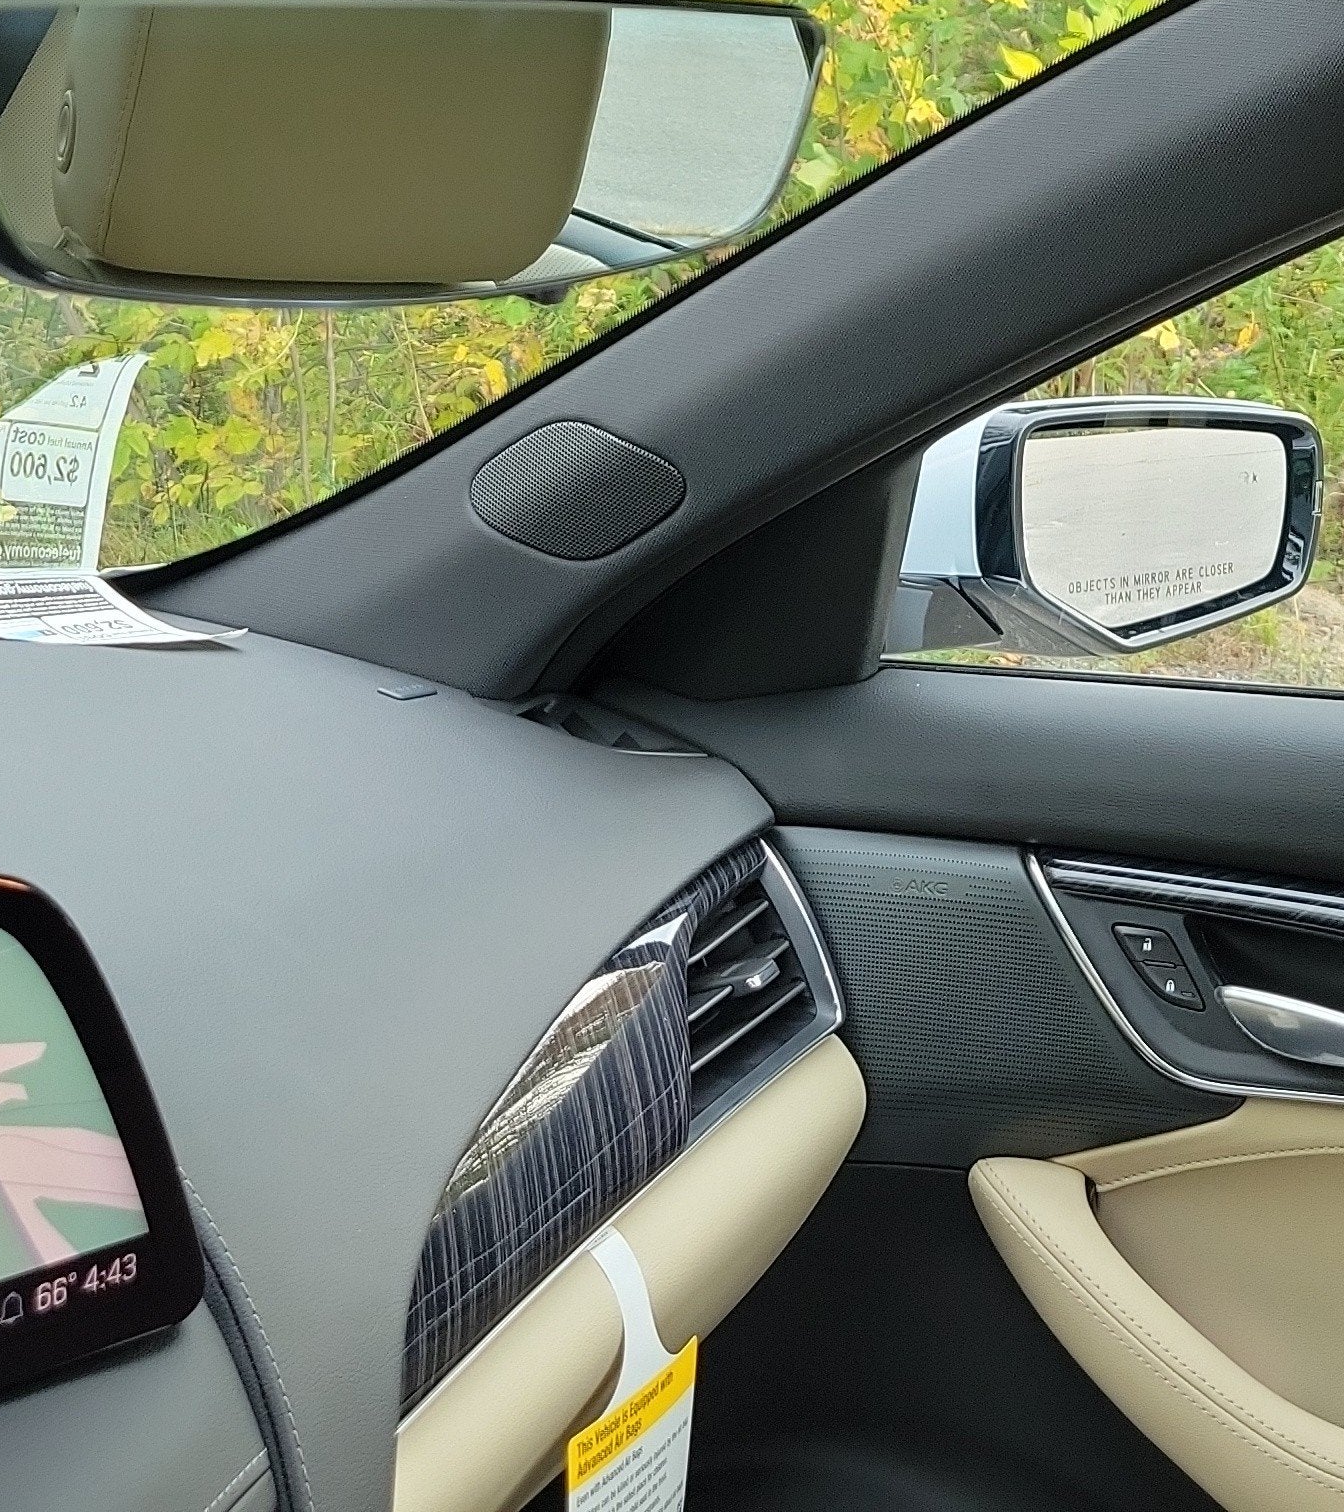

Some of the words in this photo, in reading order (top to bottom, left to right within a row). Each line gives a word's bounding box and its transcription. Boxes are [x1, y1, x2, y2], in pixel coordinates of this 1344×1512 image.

[1068, 577, 1116, 594] OBJECTS
[1120, 576, 1129, 588] IN
[1133, 570, 1170, 586] MIRROR
[1175, 567, 1194, 581] ARE
[1199, 562, 1234, 578] CLOSER
[1105, 590, 1132, 605] THAN
[1137, 586, 1161, 601] THEY
[1166, 582, 1202, 597] APPEAR
[82, 1252, 137, 1293] 4:43
[576, 1436, 594, 1458] This
[595, 1415, 621, 1445] Vehicle
[630, 1380, 660, 1418] Equipped
[577, 1437, 614, 1480] Advanced
[614, 1431, 624, 1448] Air
[626, 1418, 642, 1440] Bags
